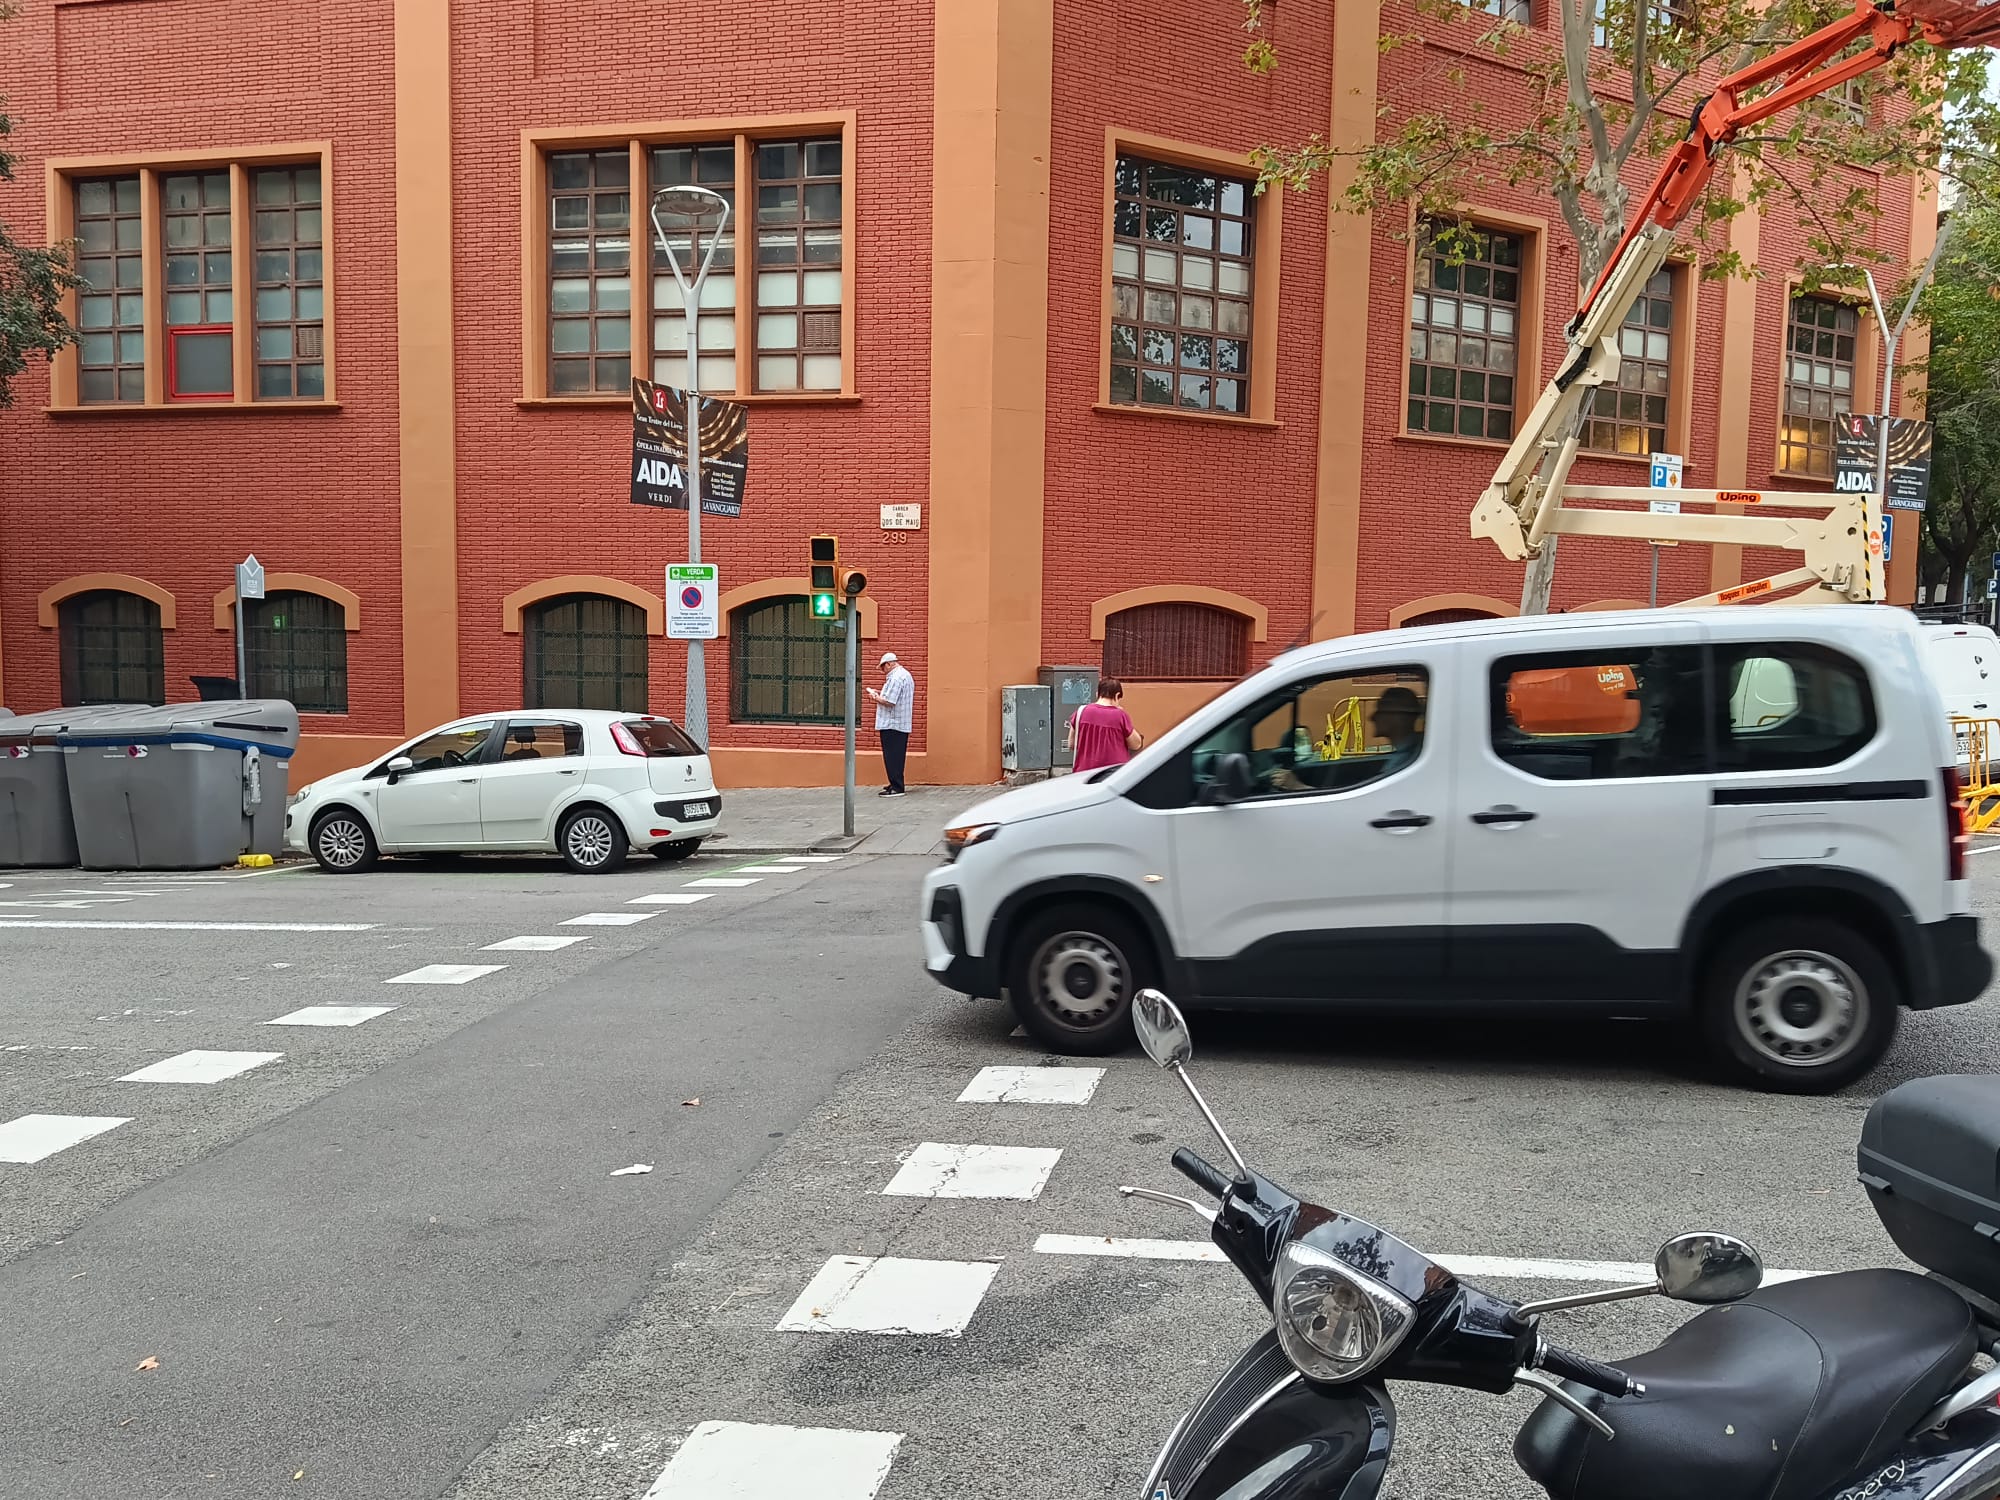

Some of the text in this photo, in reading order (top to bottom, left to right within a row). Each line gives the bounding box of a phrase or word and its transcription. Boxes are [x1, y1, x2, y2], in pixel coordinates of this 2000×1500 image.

[636, 458, 684, 489] AIDA
[1655, 468, 1664, 485] P
[1836, 471, 1873, 491] AIDA
[648, 492, 673, 503] VERDI
[1720, 492, 1757, 503] Uping
[895, 518, 903, 526] DE
[882, 531, 907, 544] 299
[1597, 669, 1625, 683] Uping
[1844, 1459, 1906, 1500] berty
